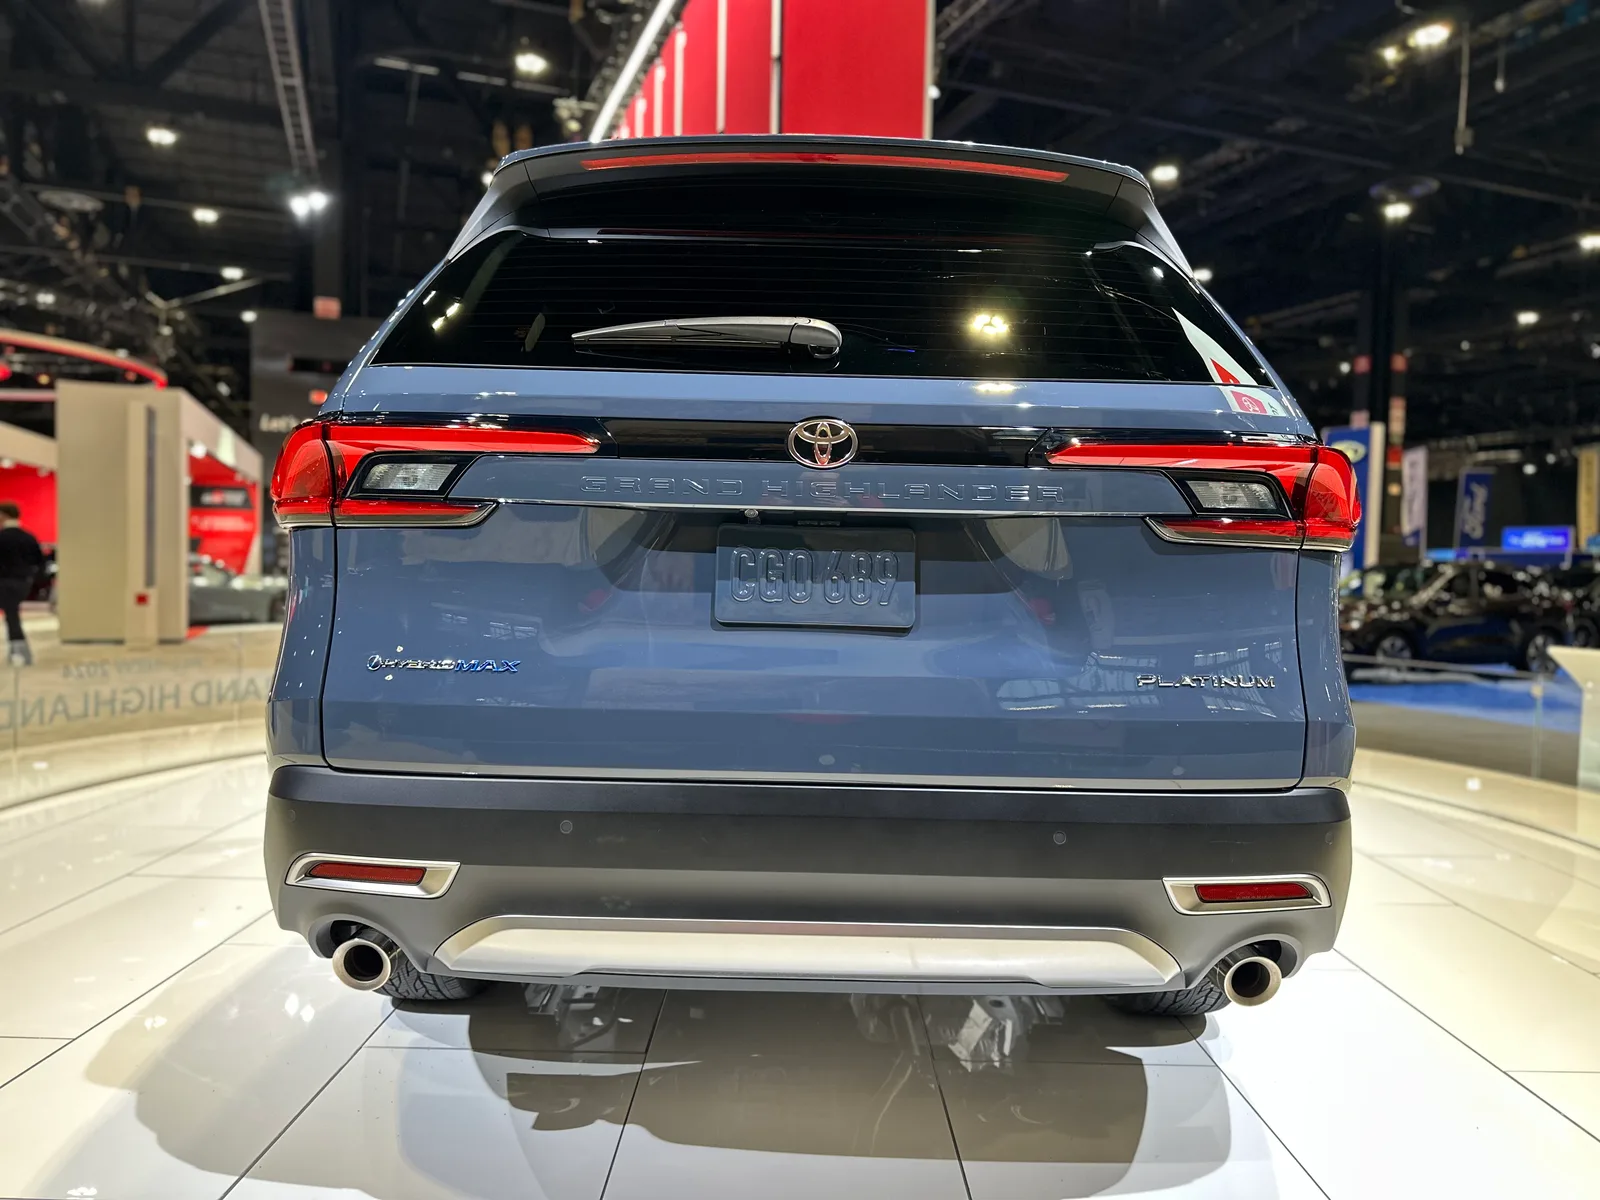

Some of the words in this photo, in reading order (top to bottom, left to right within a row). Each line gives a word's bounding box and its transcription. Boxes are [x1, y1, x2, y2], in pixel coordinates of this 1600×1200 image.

[580, 475, 743, 496] GRAND
[761, 479, 1065, 503] HIGHLANDER
[823, 549, 899, 606] 689
[1137, 674, 1276, 688] PLATINUM
